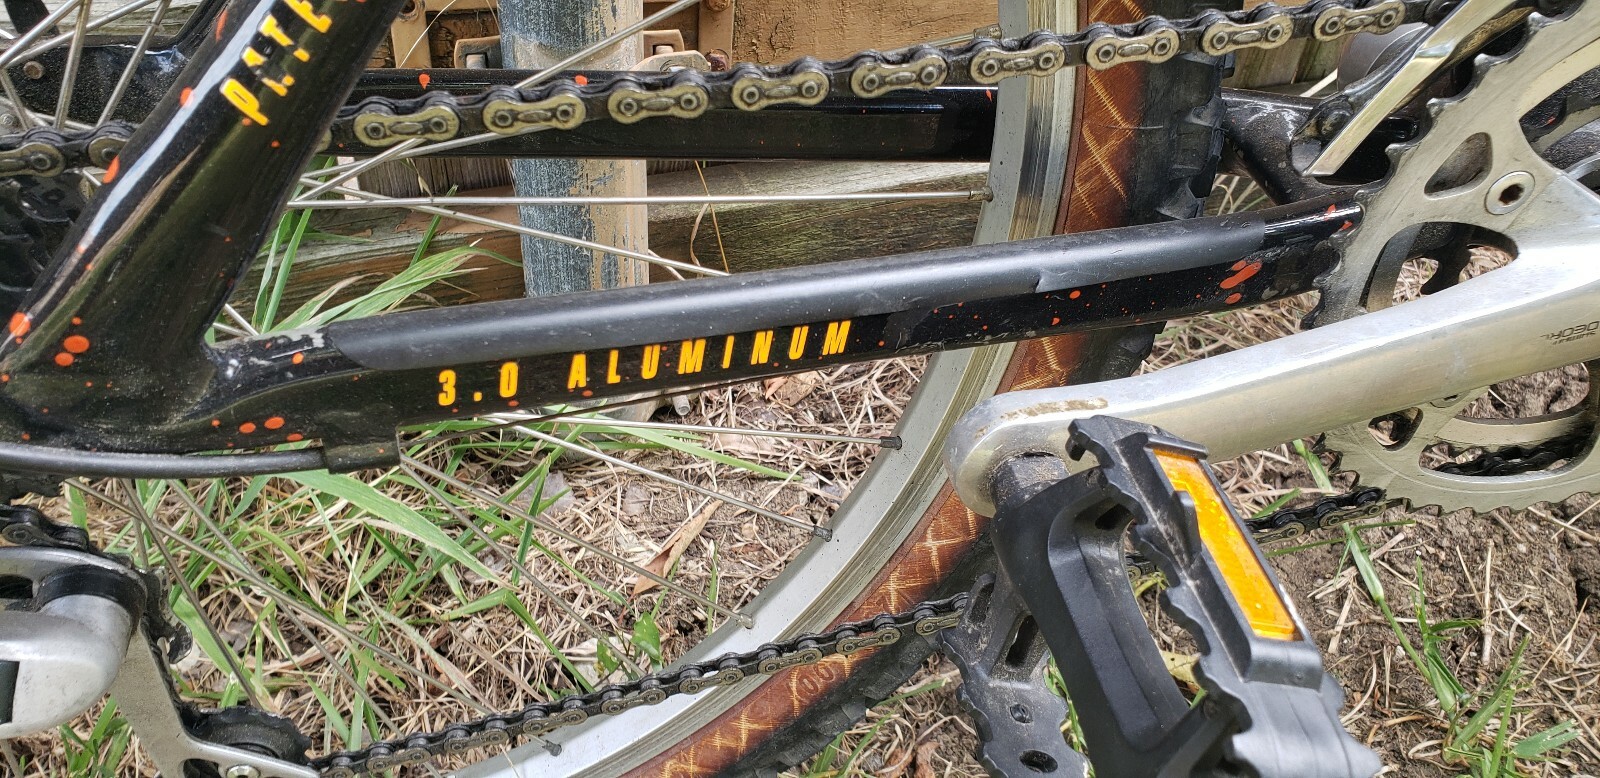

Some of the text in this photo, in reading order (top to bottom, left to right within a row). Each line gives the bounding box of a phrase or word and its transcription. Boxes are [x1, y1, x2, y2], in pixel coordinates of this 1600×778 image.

[219, 0, 333, 126] PATE
[438, 320, 852, 407] 3.0 ALUMINUM
